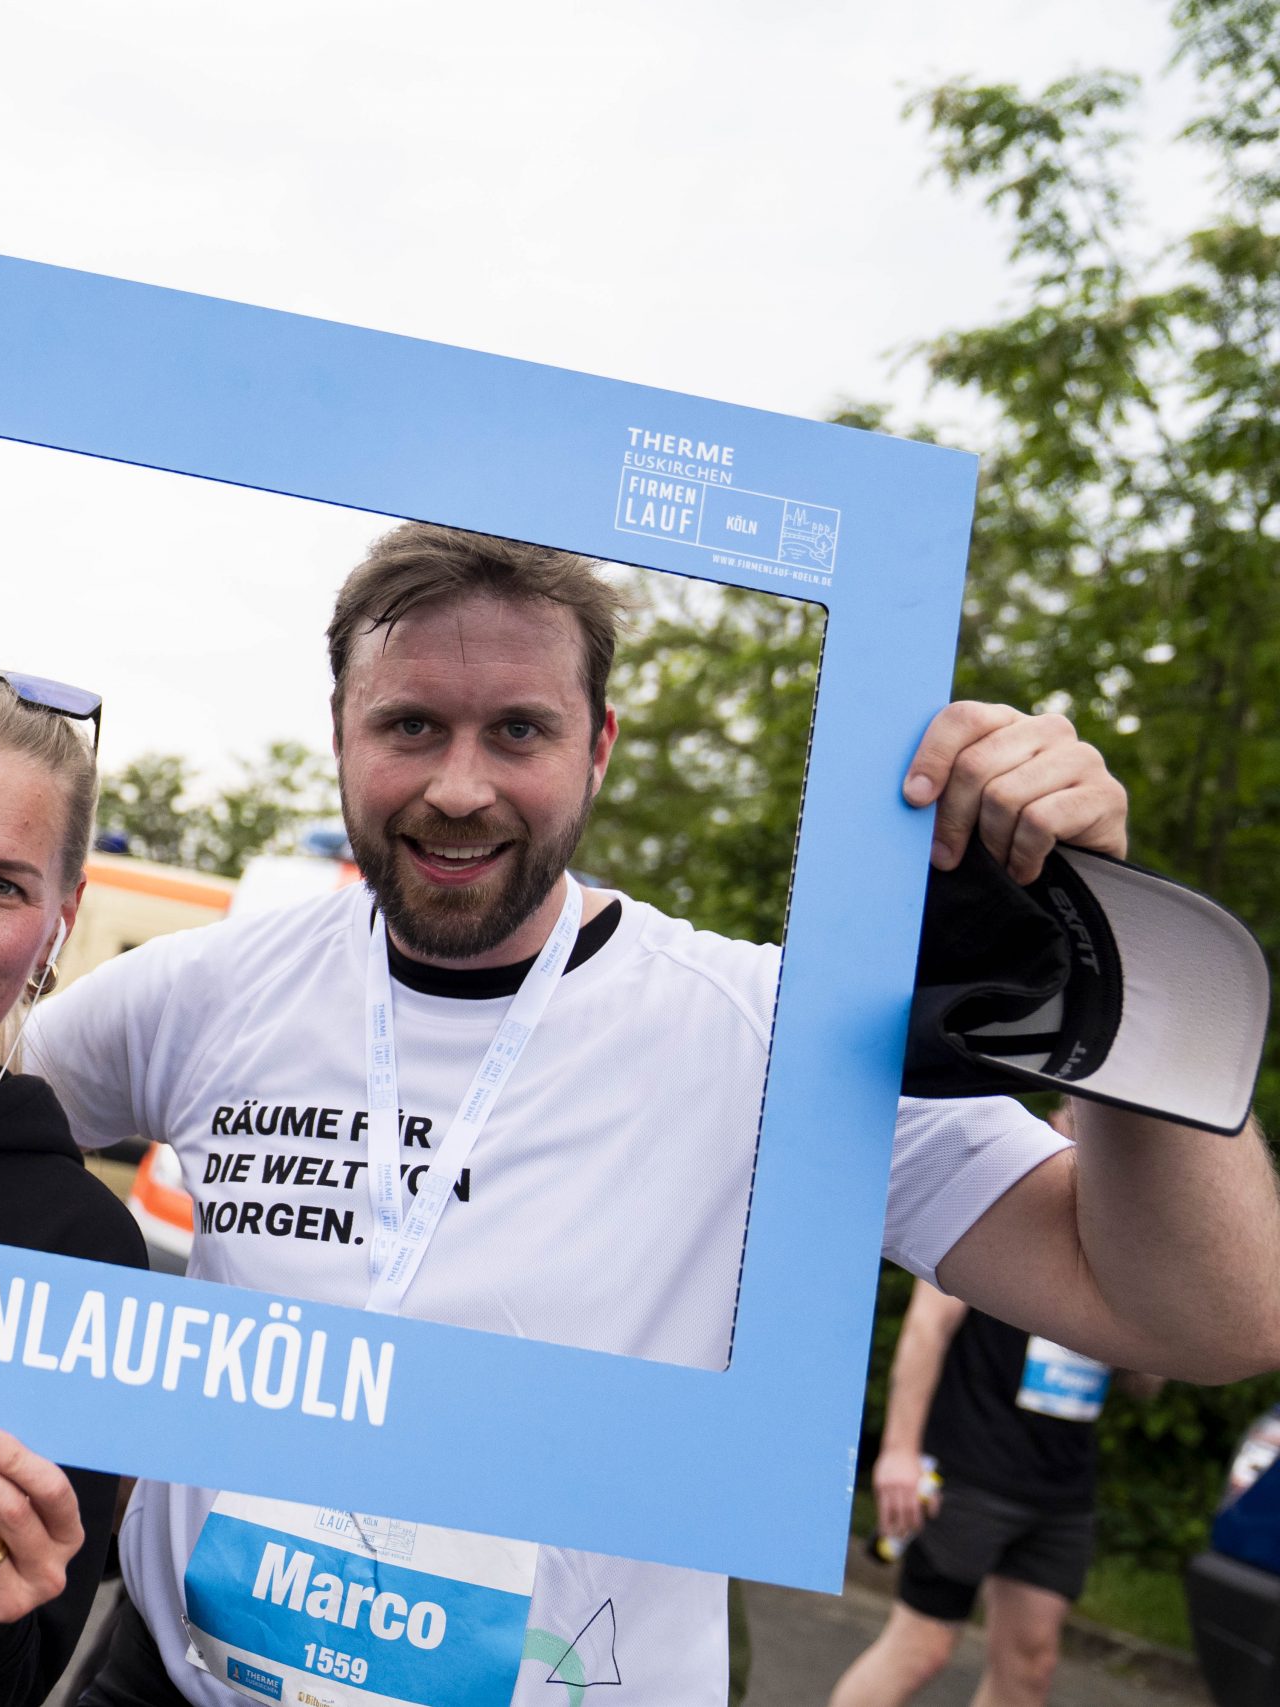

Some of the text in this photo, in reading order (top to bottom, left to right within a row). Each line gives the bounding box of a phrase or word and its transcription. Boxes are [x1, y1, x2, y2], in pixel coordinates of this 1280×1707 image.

[627, 427, 734, 466] THERME
[623, 451, 732, 485] EUSKIRCHEN
[629, 476, 696, 505] FIRMEN
[625, 498, 693, 534] LAUF
[726, 515, 757, 535] KÖLN
[712, 553, 832, 587] WWW.FIRMENLAUF-KOELN.DE
[212, 1100, 343, 1139] RÄUME
[202, 1153, 255, 1184] DIE
[261, 1155, 369, 1189] WELT
[198, 1201, 364, 1246] MORGEN.
[319, 1513, 352, 1533] LAUF
[252, 1541, 447, 1650] Marco
[245, 1669, 279, 1688] THERME
[304, 1643, 368, 1684] 1559
